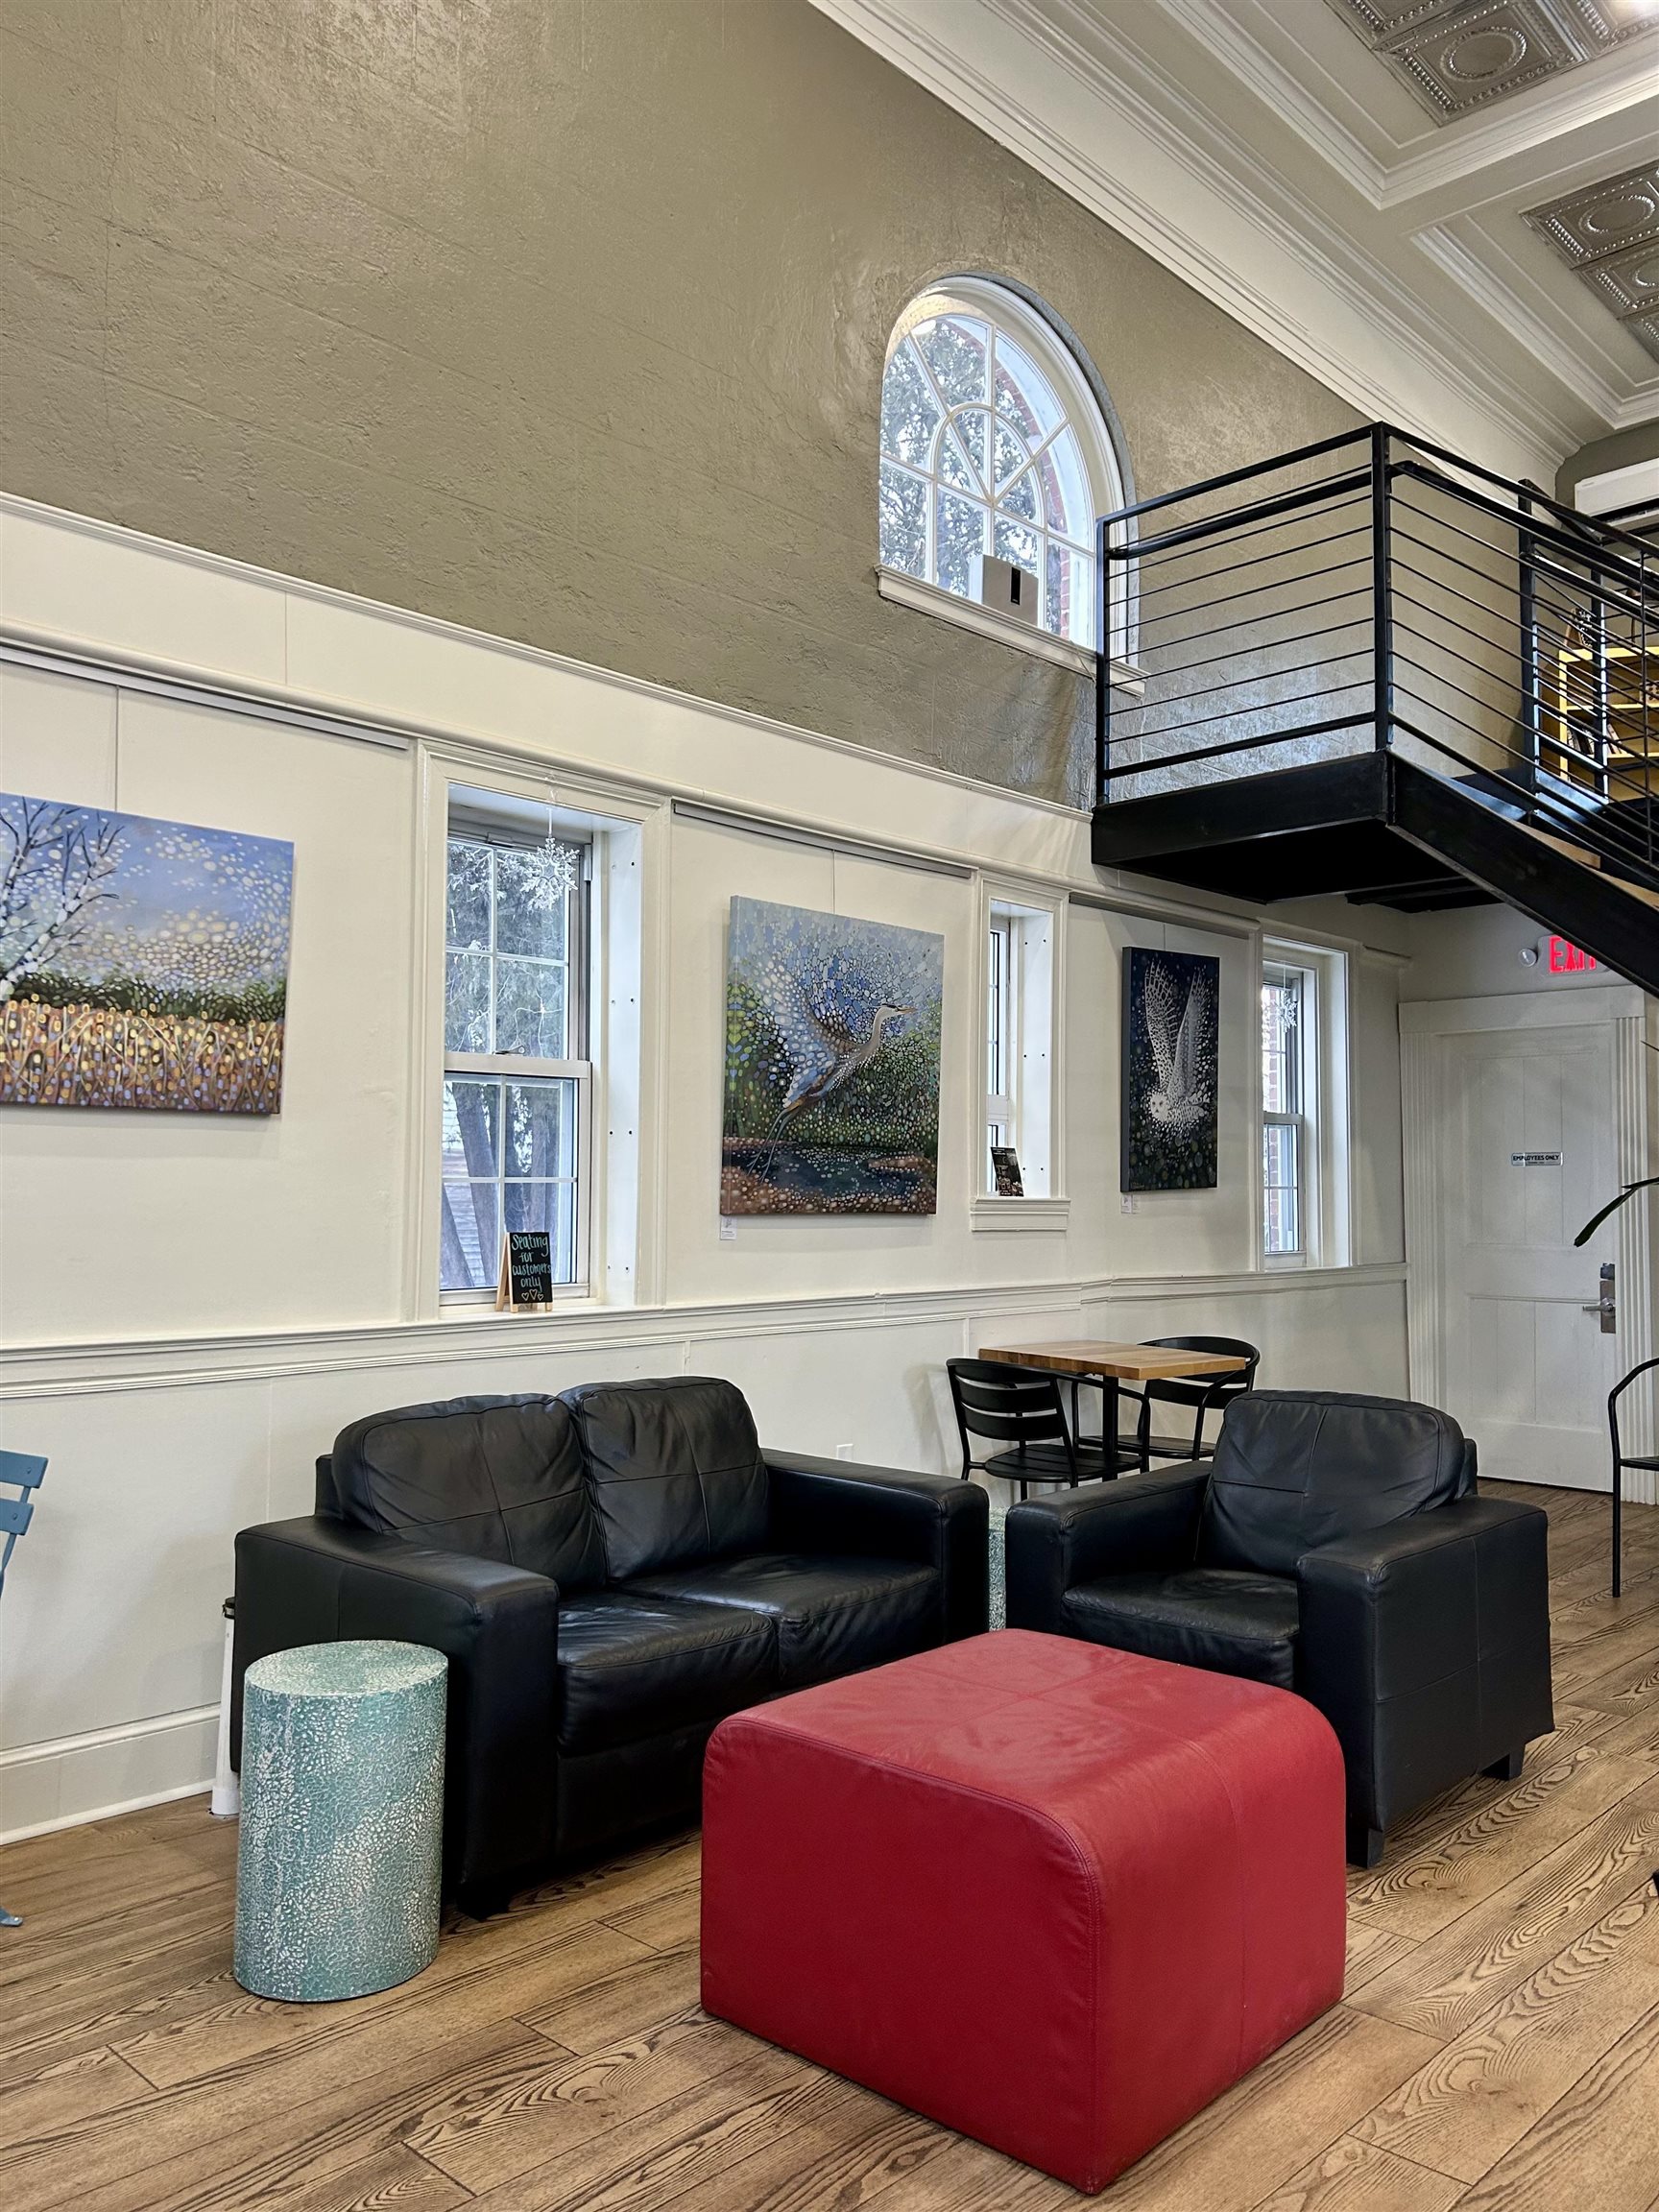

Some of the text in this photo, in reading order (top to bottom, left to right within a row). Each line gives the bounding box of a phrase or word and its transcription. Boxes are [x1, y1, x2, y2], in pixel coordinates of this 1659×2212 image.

[511, 1234, 549, 1258] Seating
[518, 1251, 535, 1262] for
[512, 1263, 552, 1276] customers
[520, 1276, 542, 1293] only
